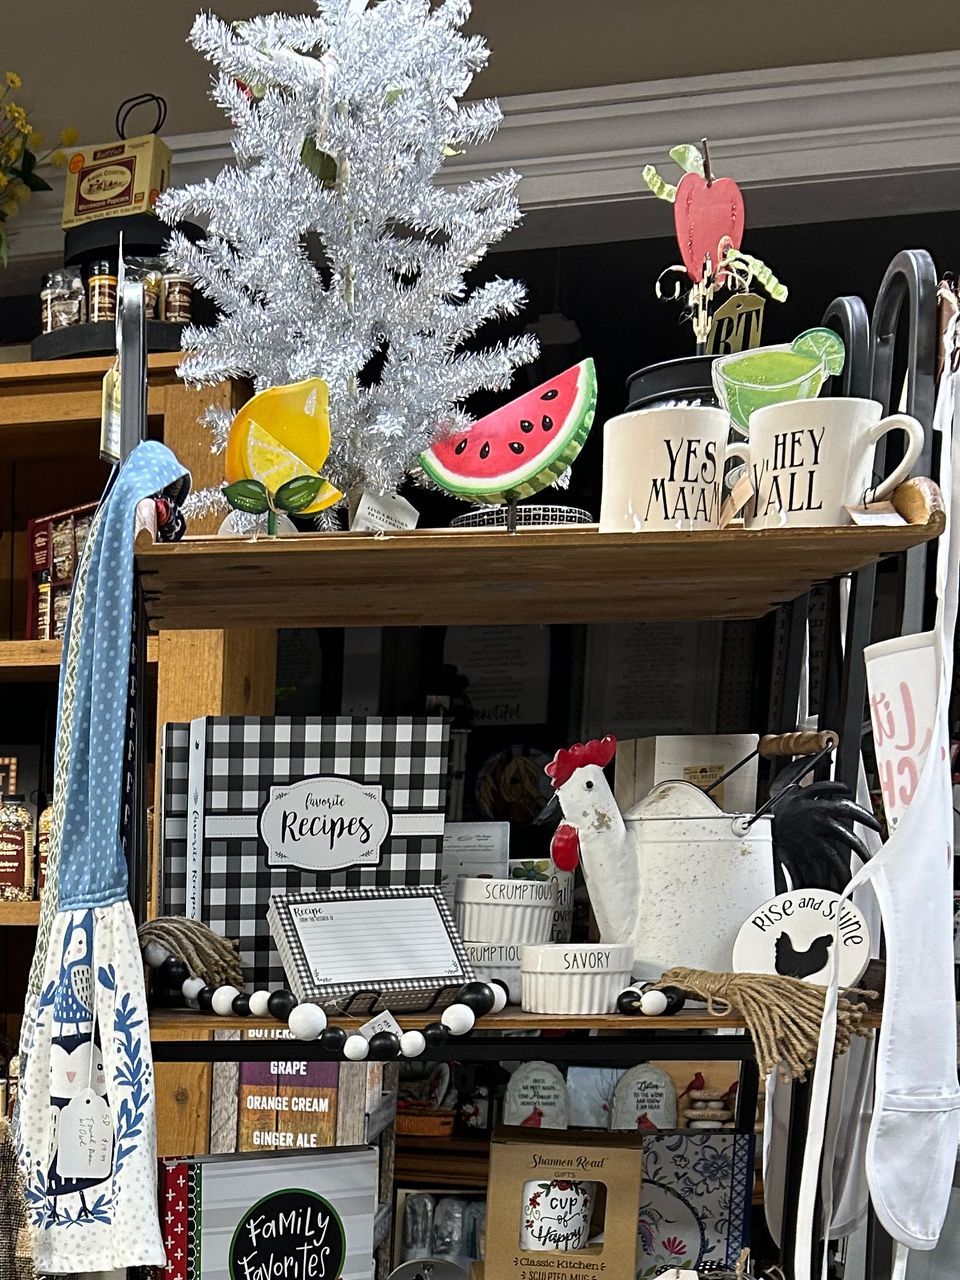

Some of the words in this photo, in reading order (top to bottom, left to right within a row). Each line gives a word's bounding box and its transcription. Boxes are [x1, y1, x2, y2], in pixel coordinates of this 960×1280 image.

[772, 427, 825, 470] HEY
[664, 437, 717, 484] YES
[752, 458, 824, 518] Y'ALL
[305, 792, 346, 810] favorite
[281, 811, 373, 850] Recipes
[485, 883, 553, 900] SCRUMPTIOUS
[563, 951, 611, 969] SAVORY
[270, 1061, 308, 1075] GRAPE
[246, 1096, 289, 1111] ORANGE
[291, 1097, 329, 1112] CREAM
[253, 1131, 293, 1146] GINGER
[296, 1133, 317, 1148] ALE
[529, 1154, 574, 1169] Shannon
[575, 1156, 605, 1171] Road
[531, 1225, 584, 1251] Happy
[519, 1258, 555, 1268] Classic
[556, 1259, 600, 1271] Kitchen
